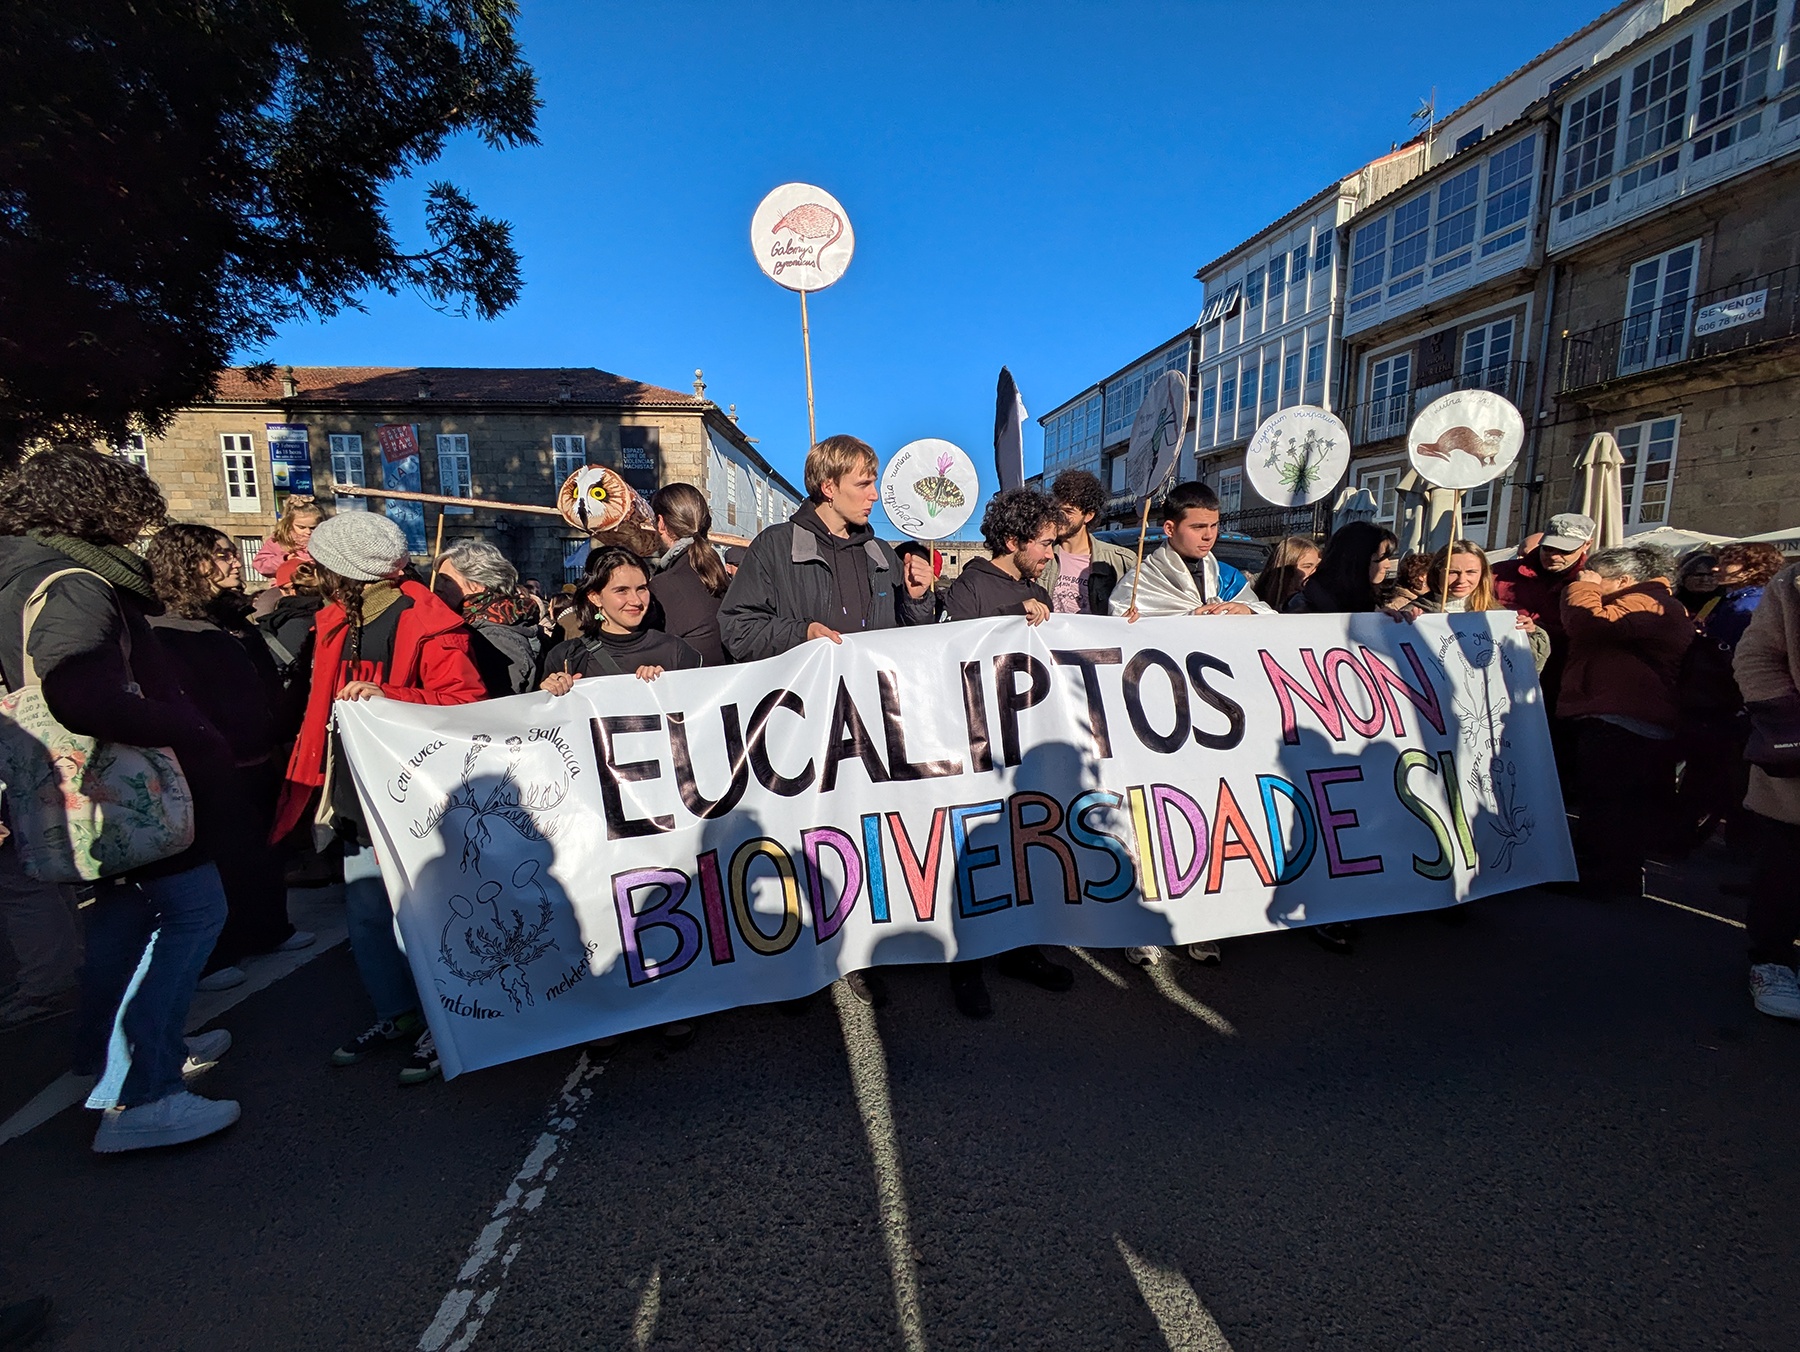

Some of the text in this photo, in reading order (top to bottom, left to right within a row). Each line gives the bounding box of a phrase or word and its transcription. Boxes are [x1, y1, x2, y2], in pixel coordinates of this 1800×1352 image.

[770, 238, 813, 260] Galemys
[1697, 308, 1762, 332] 606 78 70 64
[1700, 293, 1764, 319] SE VENDE
[1250, 414, 1287, 454] Eryngium
[890, 452, 912, 478] rumina
[589, 642, 1446, 840] EUCALIPTOS NON
[387, 725, 581, 803] Centaurea gallaecica
[611, 748, 1477, 988] BIODIVERSIDADE SI
